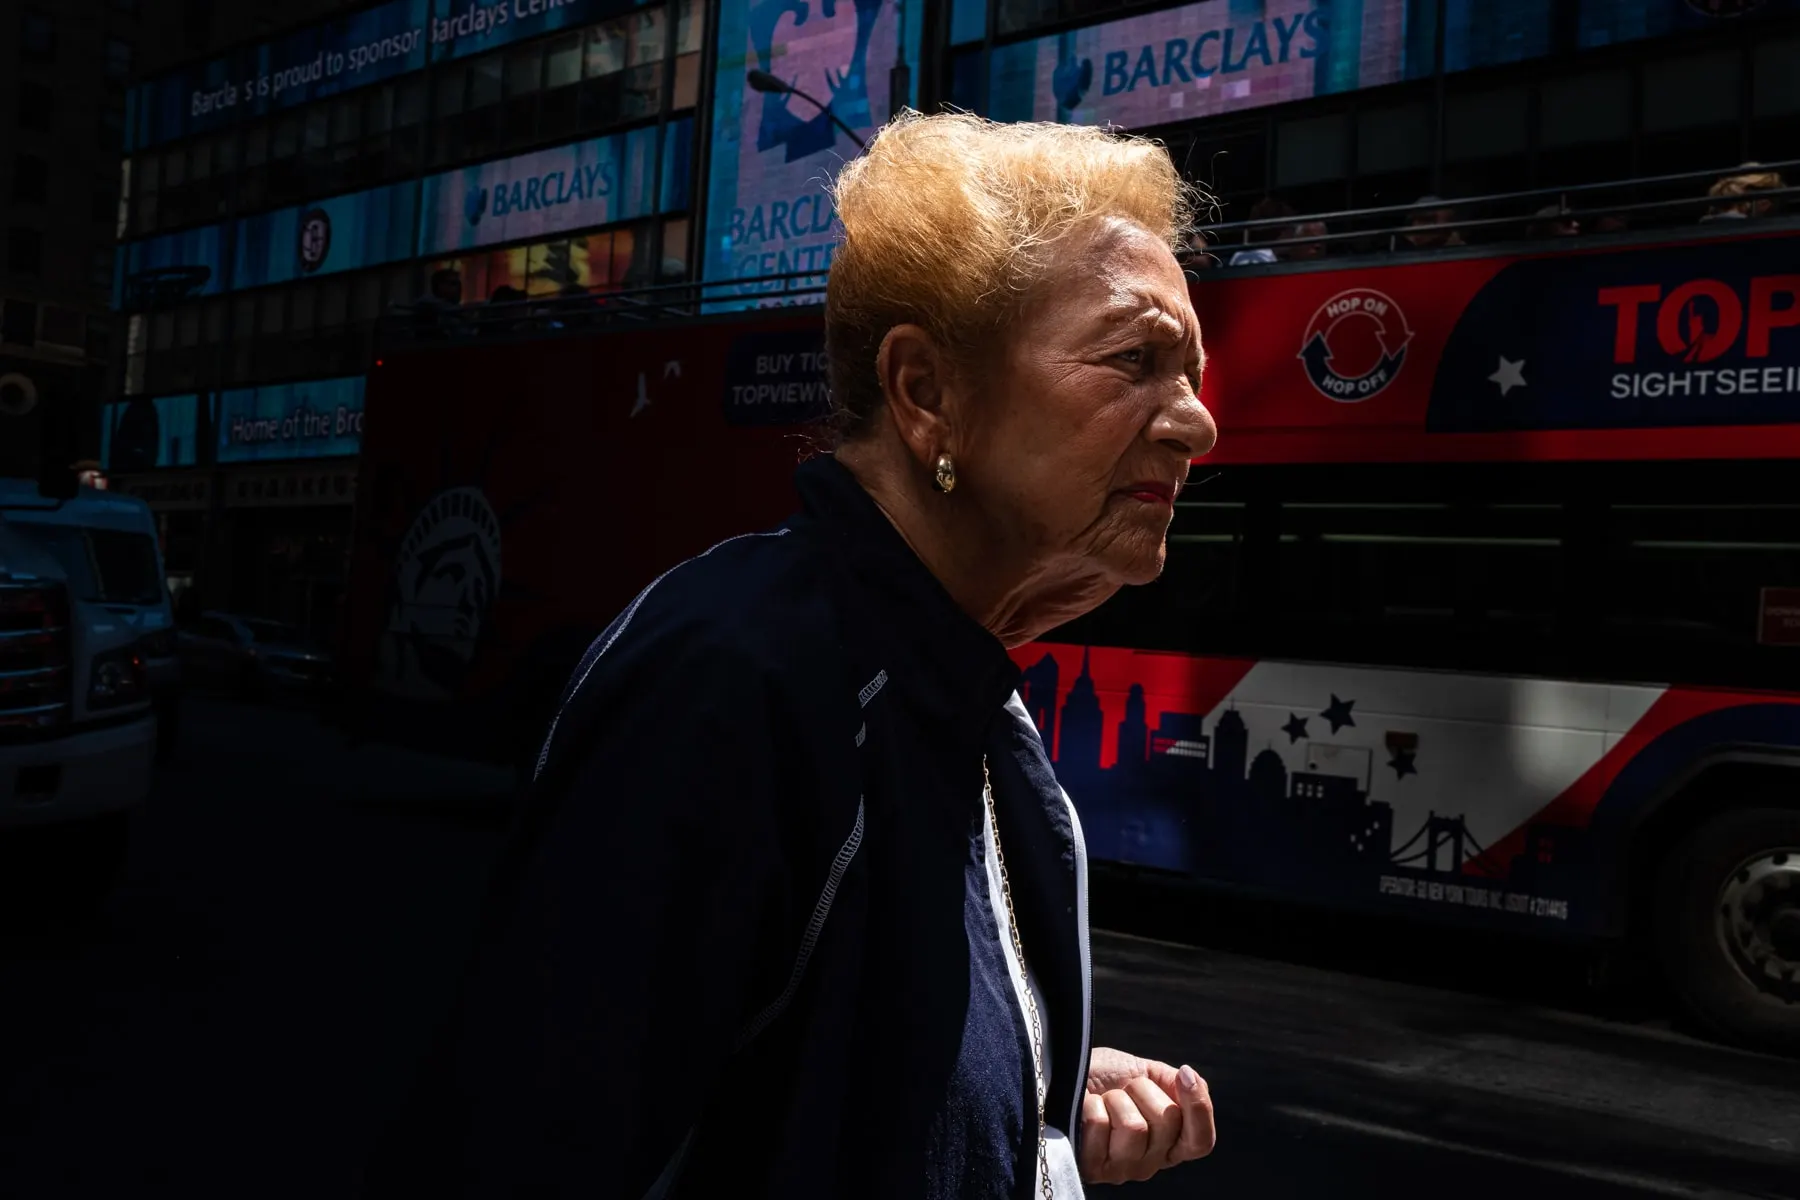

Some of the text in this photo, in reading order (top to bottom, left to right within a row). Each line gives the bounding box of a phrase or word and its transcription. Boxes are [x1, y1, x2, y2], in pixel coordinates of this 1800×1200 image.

[190, 27, 422, 117] Barclas is proud to sponsor
[1103, 11, 1326, 97] BARCLAYS
[492, 161, 613, 217] BARCLAYS
[1326, 297, 1389, 318] HOP ON
[1596, 273, 1800, 366] TOP
[756, 353, 795, 375] BUY
[1322, 368, 1388, 395] HOP OFF
[1610, 366, 1800, 400] SIGHTSEEI
[230, 416, 280, 442] Home
[281, 407, 300, 437] of
[302, 404, 331, 436] the
